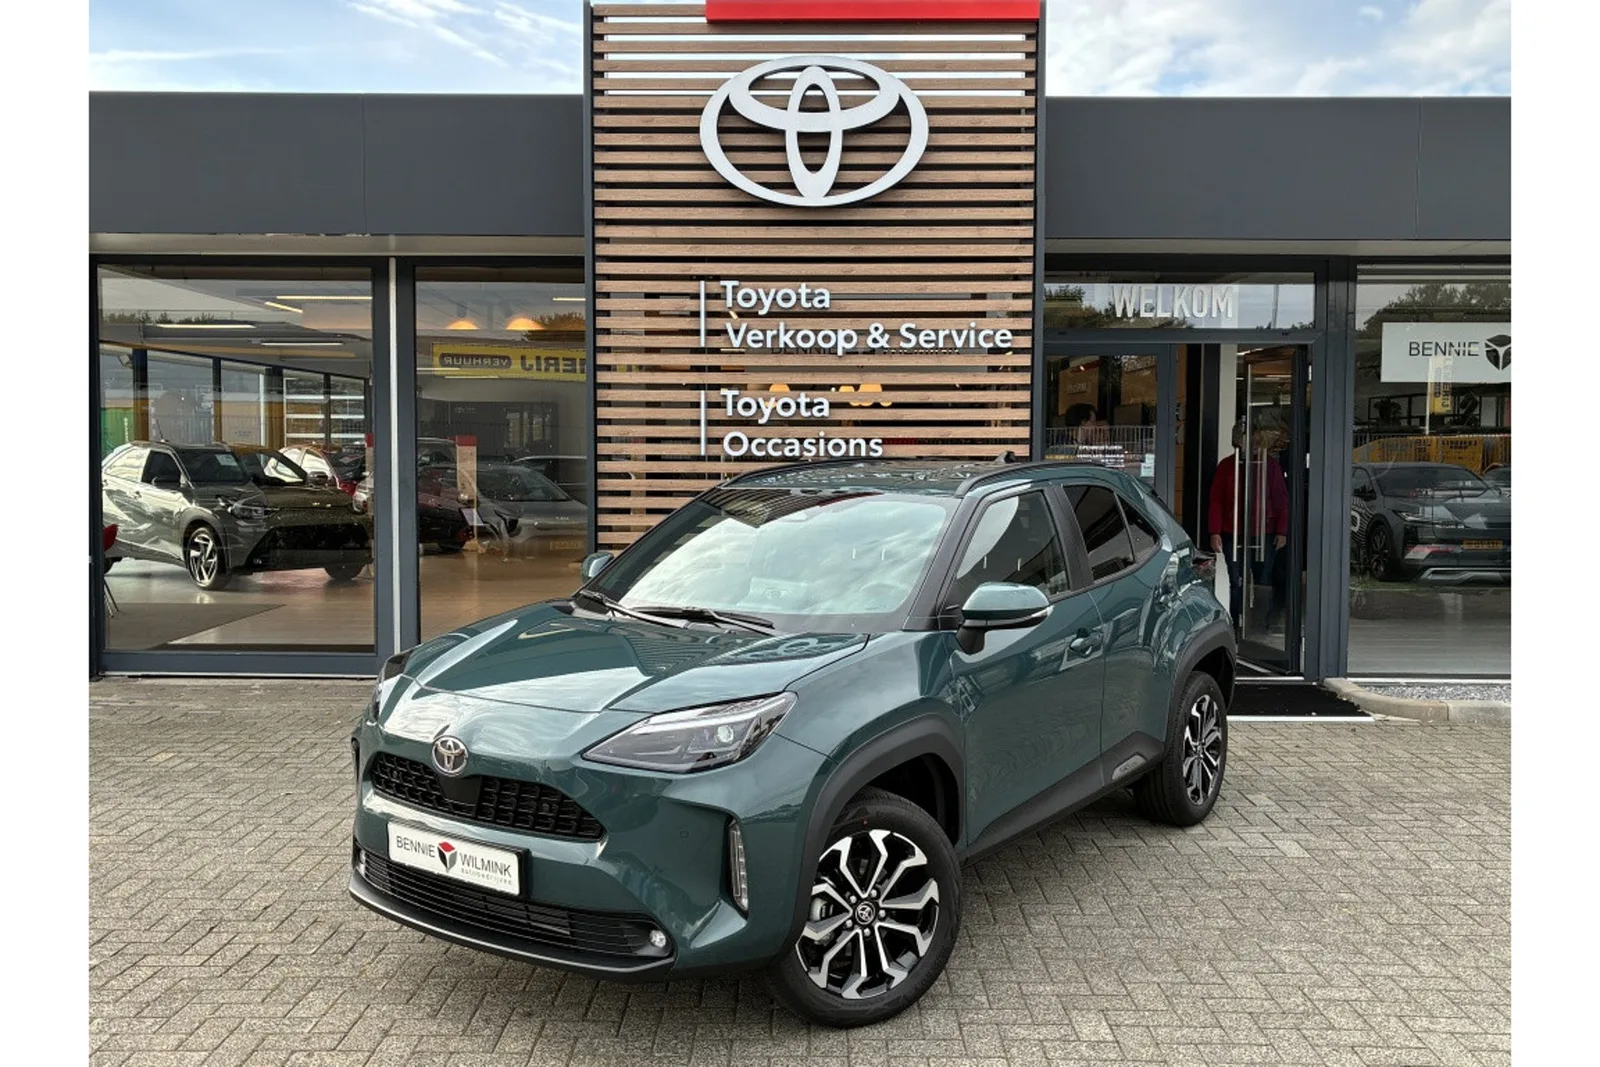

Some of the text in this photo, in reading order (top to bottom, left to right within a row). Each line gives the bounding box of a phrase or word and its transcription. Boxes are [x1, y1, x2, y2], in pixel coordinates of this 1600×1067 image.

[720, 280, 830, 315] Toyota
[1111, 284, 1235, 318] WELKOM
[725, 322, 1012, 356] Verkoop & Service
[1408, 341, 1479, 356] BENNIE
[720, 390, 830, 424] Toyota
[723, 431, 883, 458] Occasions
[396, 835, 435, 858] BENNIE
[459, 852, 512, 878] WILMINK
